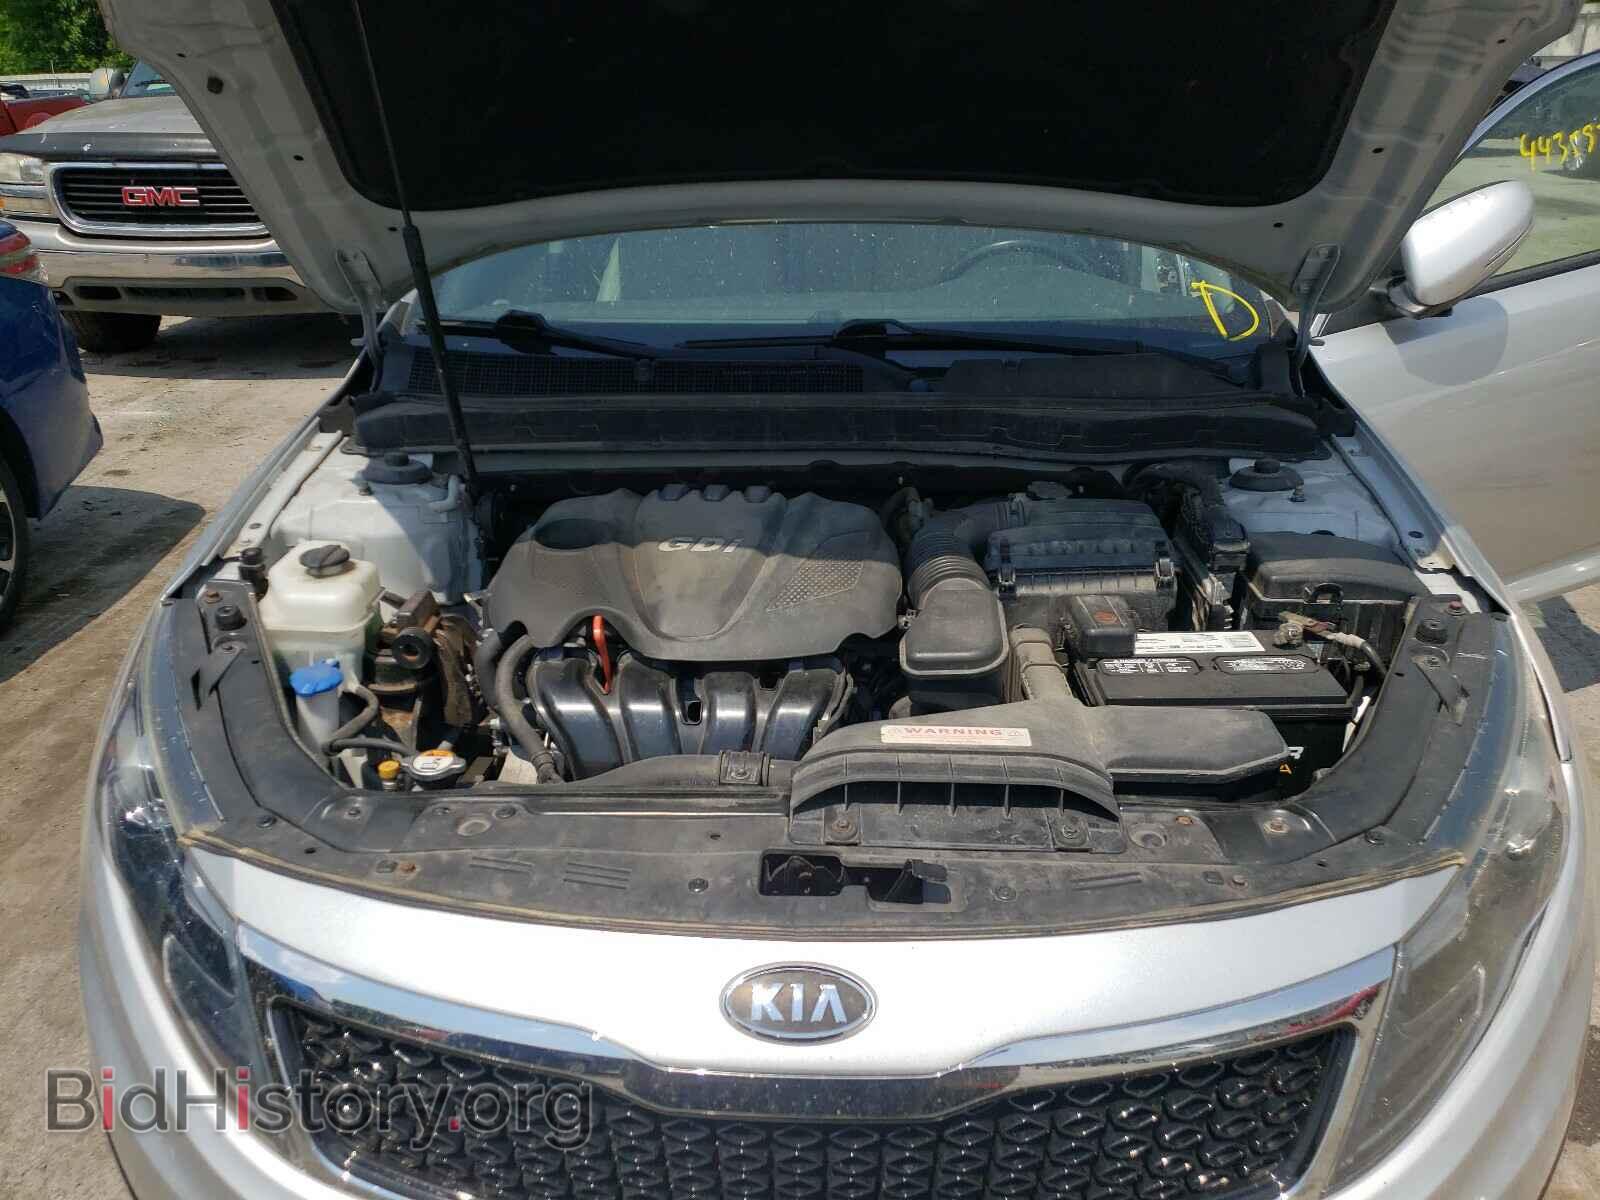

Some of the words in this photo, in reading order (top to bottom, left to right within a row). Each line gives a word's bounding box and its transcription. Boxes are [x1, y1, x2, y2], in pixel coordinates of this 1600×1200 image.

[121, 186, 200, 206] GMC
[1191, 280, 1260, 341] D
[903, 727, 1003, 736] WARNING
[752, 983, 848, 1022] KIA
